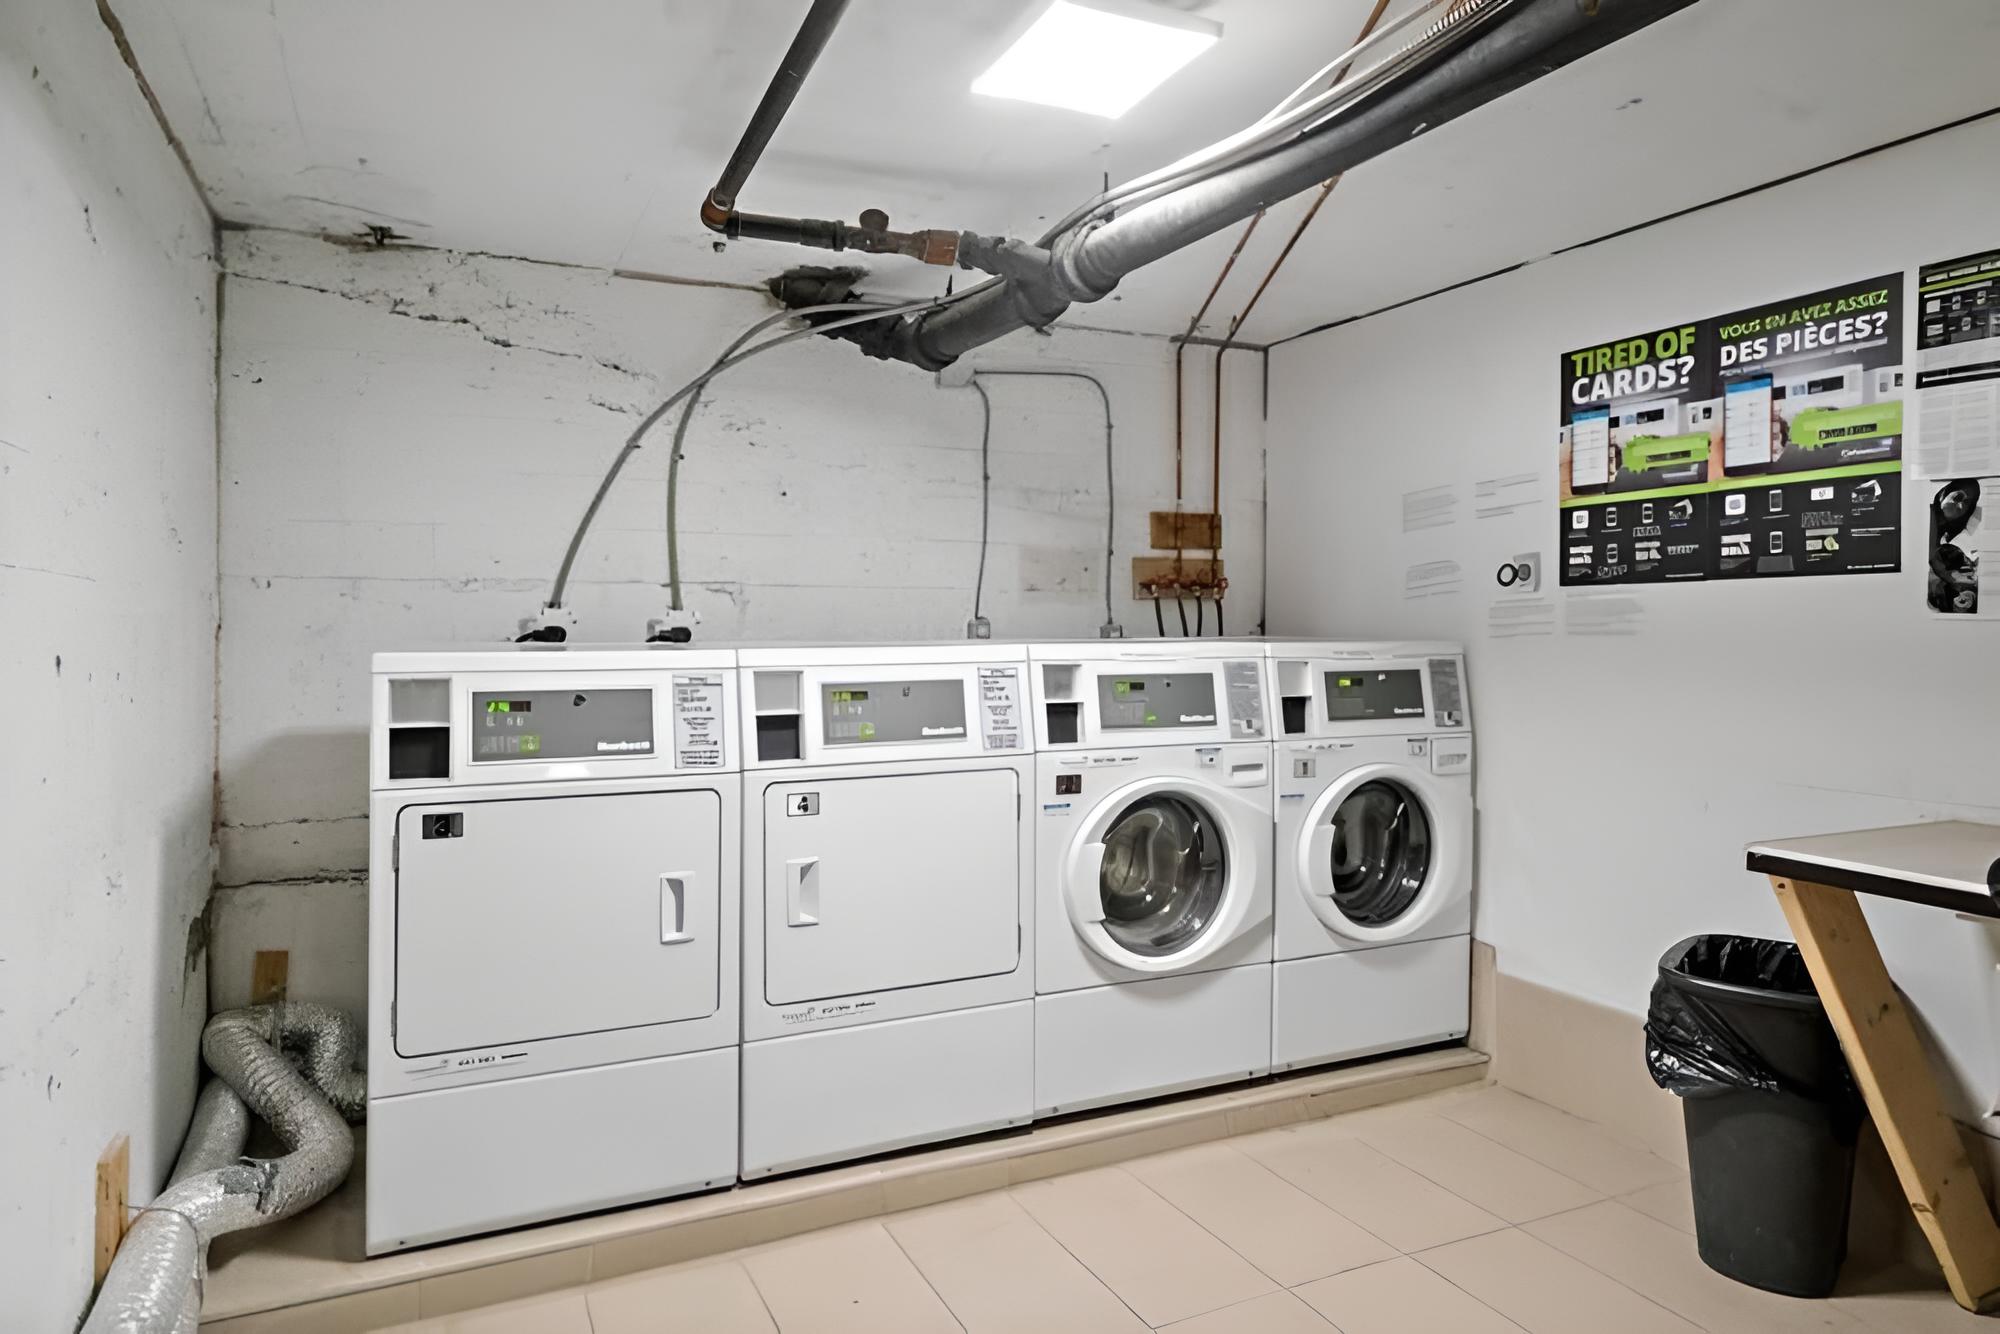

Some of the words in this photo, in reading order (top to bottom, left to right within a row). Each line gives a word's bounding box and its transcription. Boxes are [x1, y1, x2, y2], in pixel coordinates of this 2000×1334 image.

[1571, 339, 1649, 377] TIRED
[1655, 326, 1696, 359] OF
[1719, 319, 1761, 339] VOUS
[1720, 337, 1768, 367] DES
[1776, 311, 1888, 355] PIÈCES?
[1571, 355, 1695, 405] CARDS?
